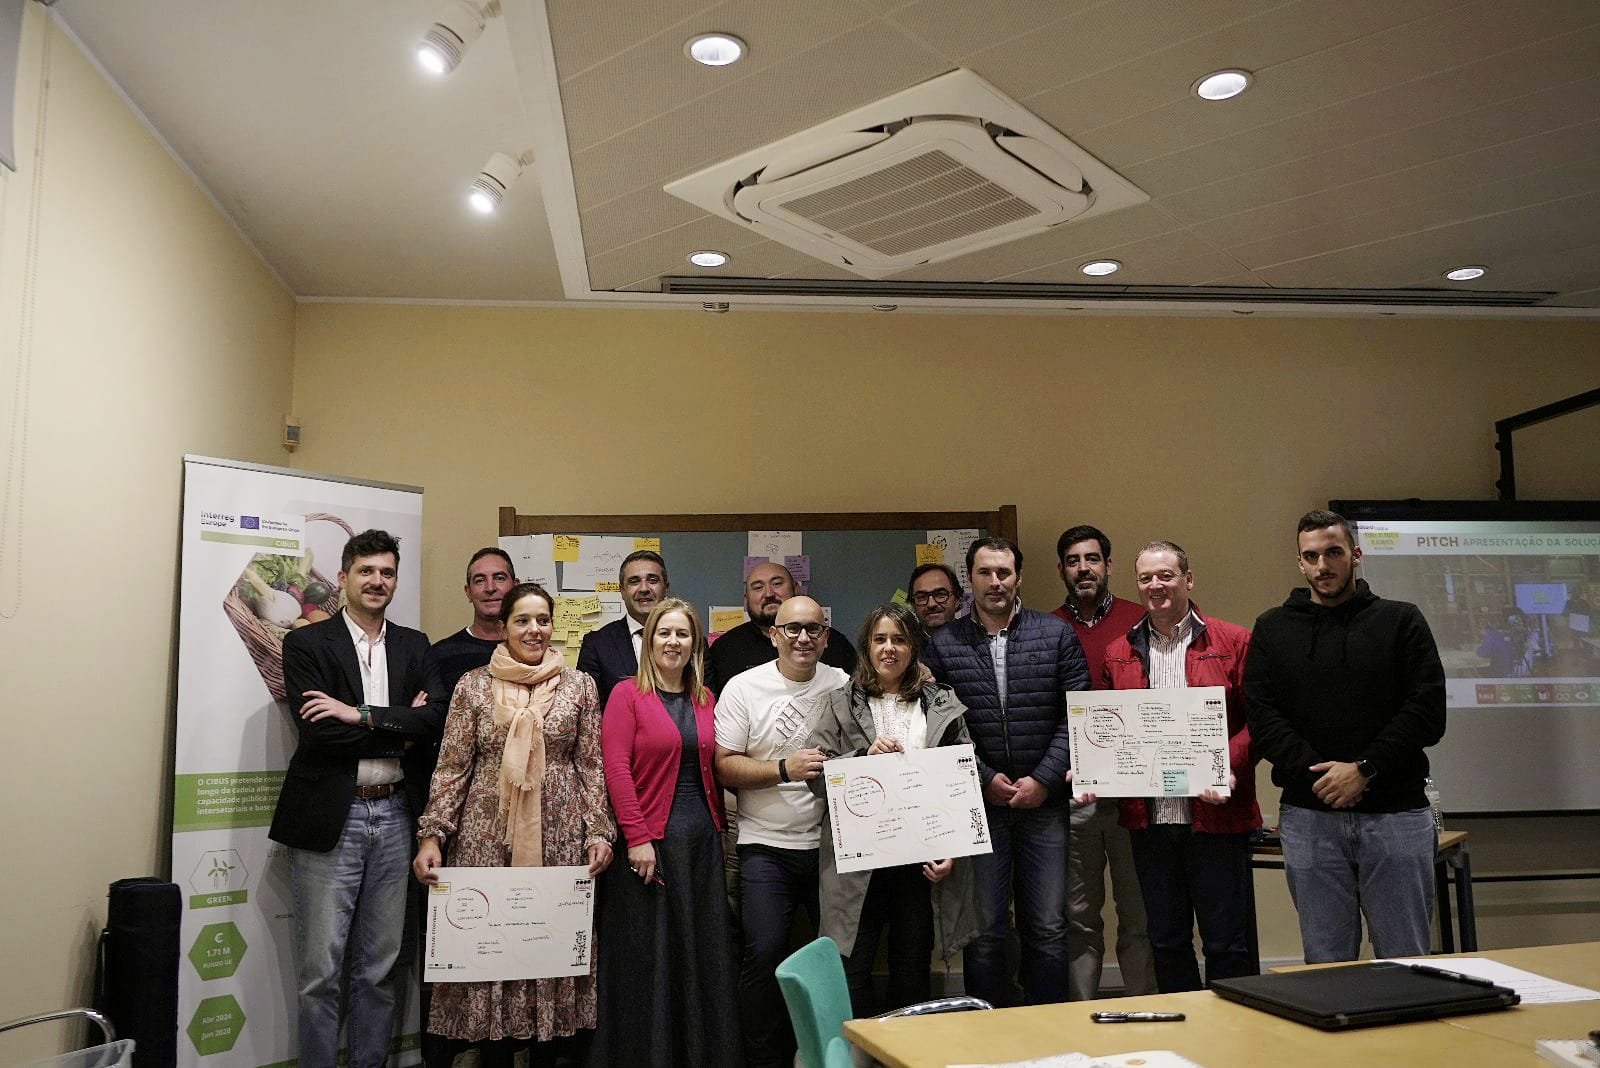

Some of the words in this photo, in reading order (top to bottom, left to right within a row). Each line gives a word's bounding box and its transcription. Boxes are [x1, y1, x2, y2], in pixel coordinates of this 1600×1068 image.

[275, 540, 297, 548] CIBUS
[1416, 536, 1458, 547] PITCH
[1462, 535, 1543, 548] APRESENTAÇÃO
[1547, 538, 1561, 546] DA
[230, 776, 263, 786] pretende
[198, 788, 220, 796] longo
[232, 786, 255, 794] cadeia
[198, 796, 240, 806] capacidade
[207, 896, 232, 904] GREEN
[206, 948, 221, 957] 1.71
[222, 946, 230, 955] M
[203, 960, 223, 968] FUNDO
[202, 1016, 214, 1024] Abr
